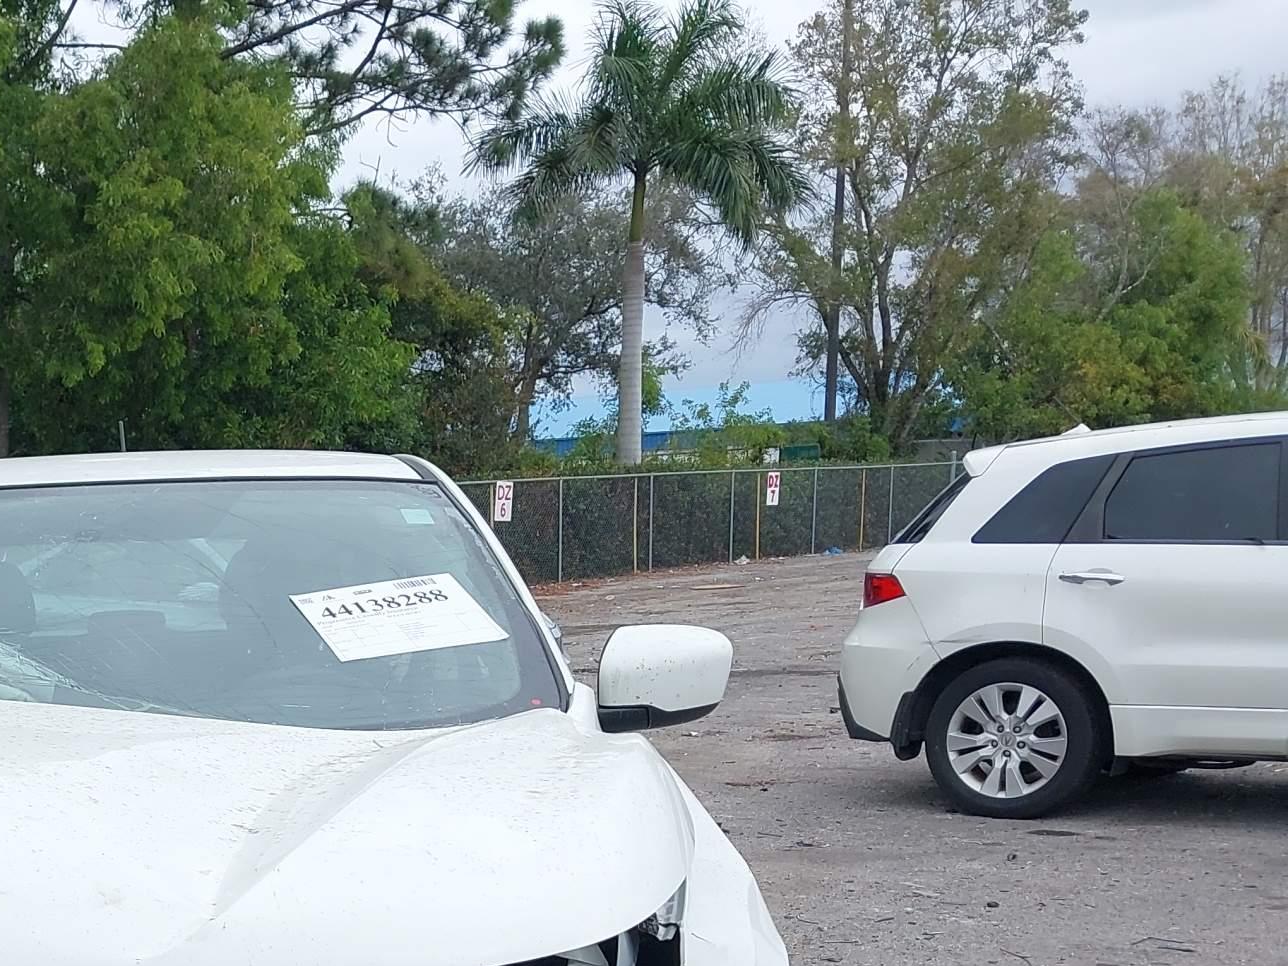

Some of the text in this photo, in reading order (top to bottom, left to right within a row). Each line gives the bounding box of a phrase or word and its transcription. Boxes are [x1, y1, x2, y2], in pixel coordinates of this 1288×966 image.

[497, 485, 512, 500] DZ
[770, 489, 776, 503] 7
[500, 502, 506, 518] 6
[321, 589, 448, 619] 44138288
